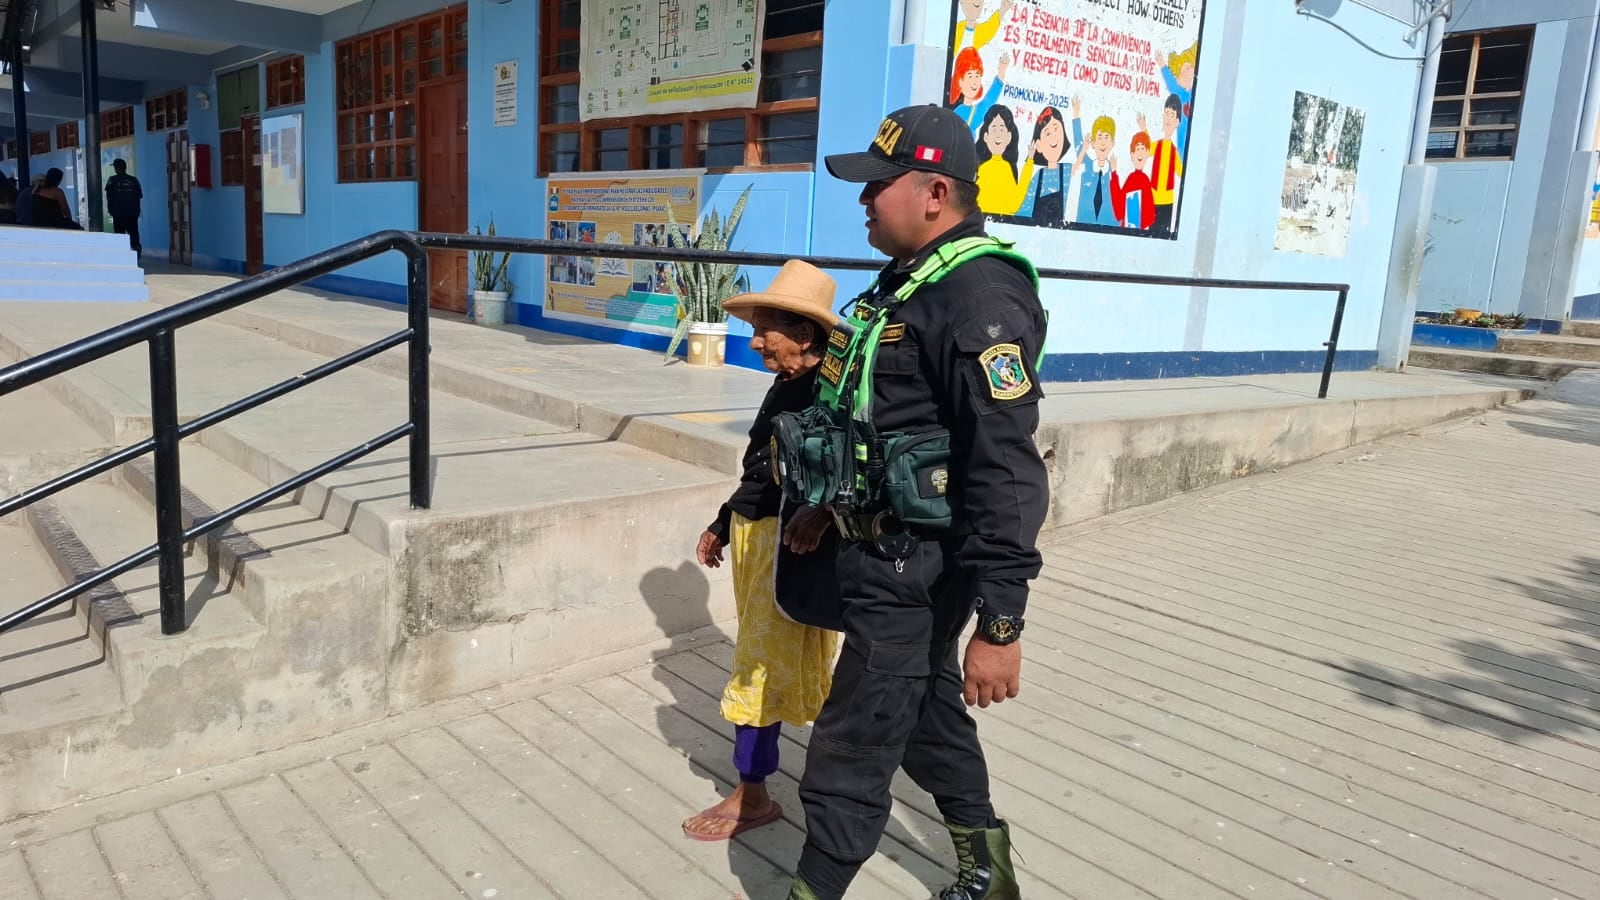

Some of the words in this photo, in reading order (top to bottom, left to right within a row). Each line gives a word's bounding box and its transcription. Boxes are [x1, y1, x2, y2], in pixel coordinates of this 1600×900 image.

[1011, 3, 1028, 24] LA
[1032, 8, 1069, 35] ESENCIA
[1073, 18, 1086, 38] DE
[1087, 23, 1098, 42] LA
[1101, 27, 1151, 56] CONVIVENCIA
[1127, 0, 1150, 18] HOW
[1153, 5, 1184, 28] OTHERS
[1003, 25, 1020, 44] ES
[1025, 29, 1082, 58] REALMENTE
[1135, 56, 1156, 76] VIVE
[1012, 48, 1020, 66] Y
[1023, 51, 1068, 77] RESPETA
[1073, 63, 1098, 84] COMO
[1103, 70, 1132, 91] OTROS
